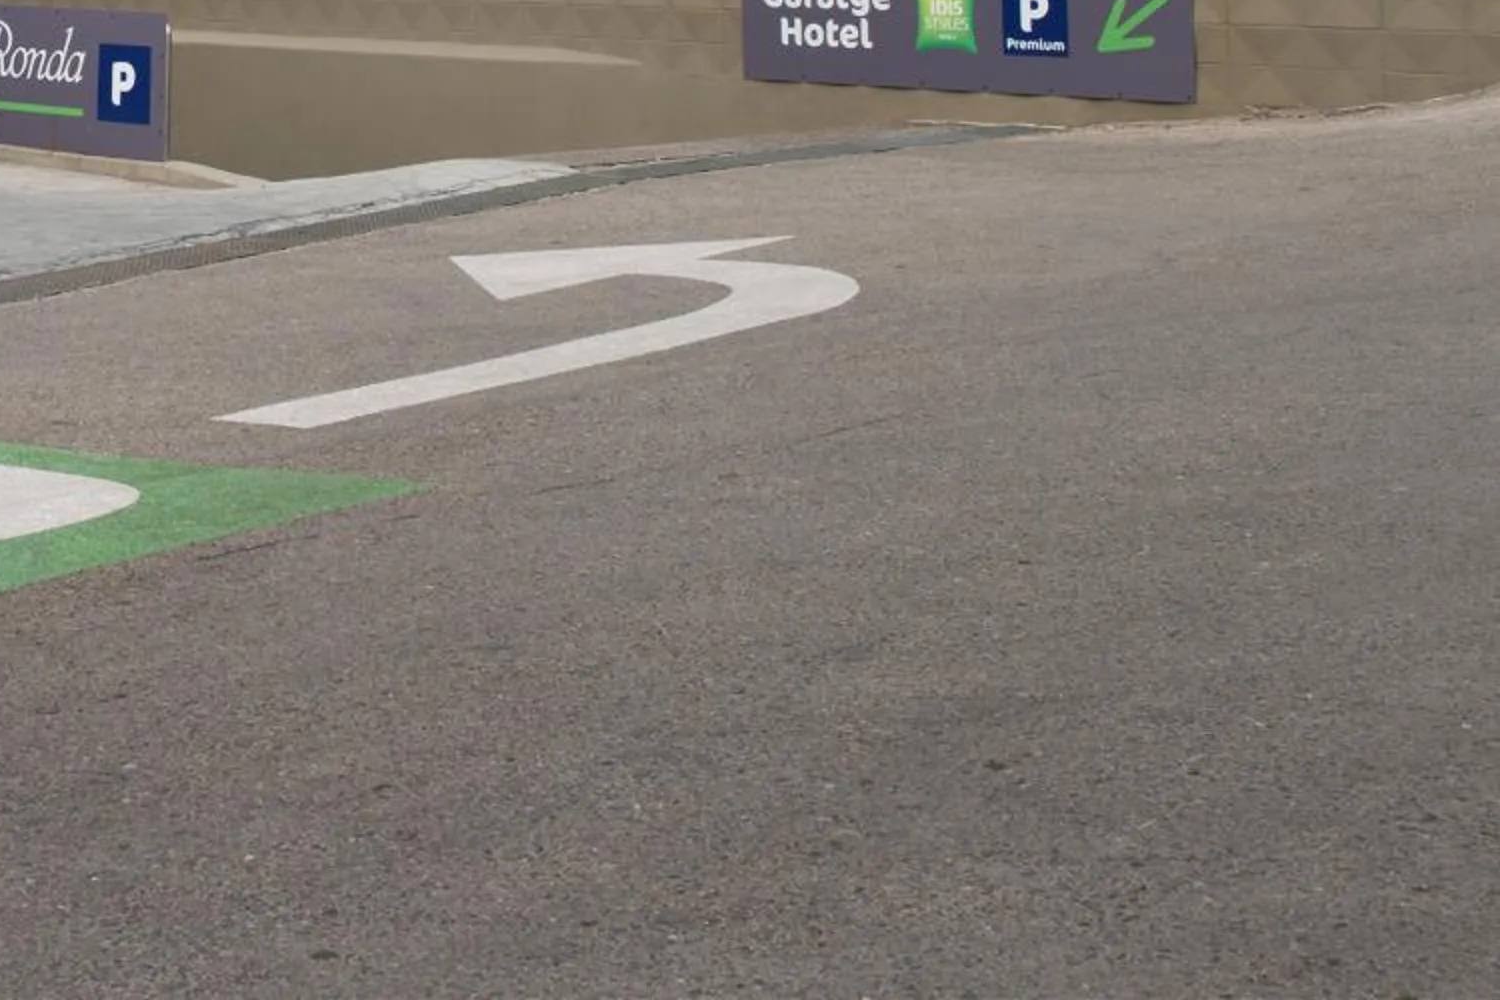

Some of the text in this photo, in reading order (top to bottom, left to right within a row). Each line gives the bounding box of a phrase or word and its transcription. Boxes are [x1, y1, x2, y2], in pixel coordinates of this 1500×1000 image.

[780, 16, 873, 50] Hotel
[1006, 36, 1066, 53] Premium
[110, 60, 137, 107] P
